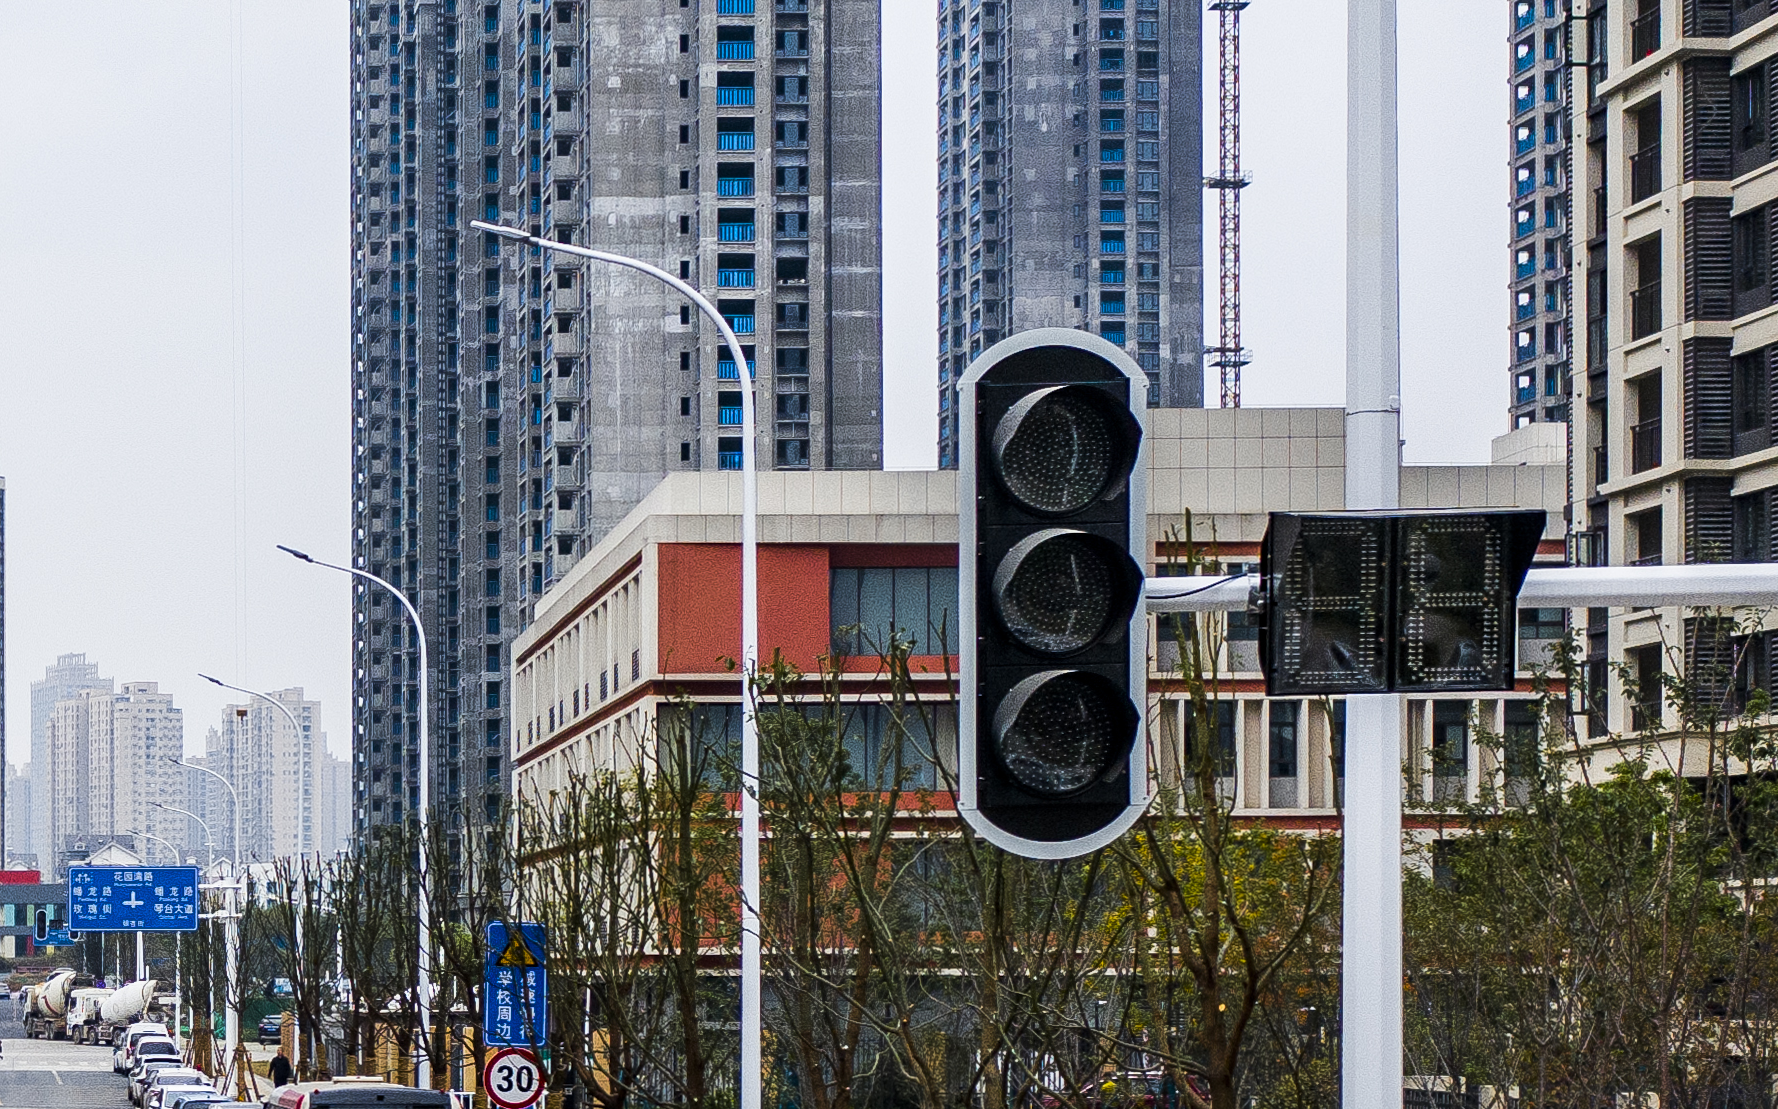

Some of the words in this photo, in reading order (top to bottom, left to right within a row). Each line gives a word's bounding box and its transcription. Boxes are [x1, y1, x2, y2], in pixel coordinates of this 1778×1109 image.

[495, 970, 513, 1040] 学校周边
[496, 1064, 535, 1093] 30
